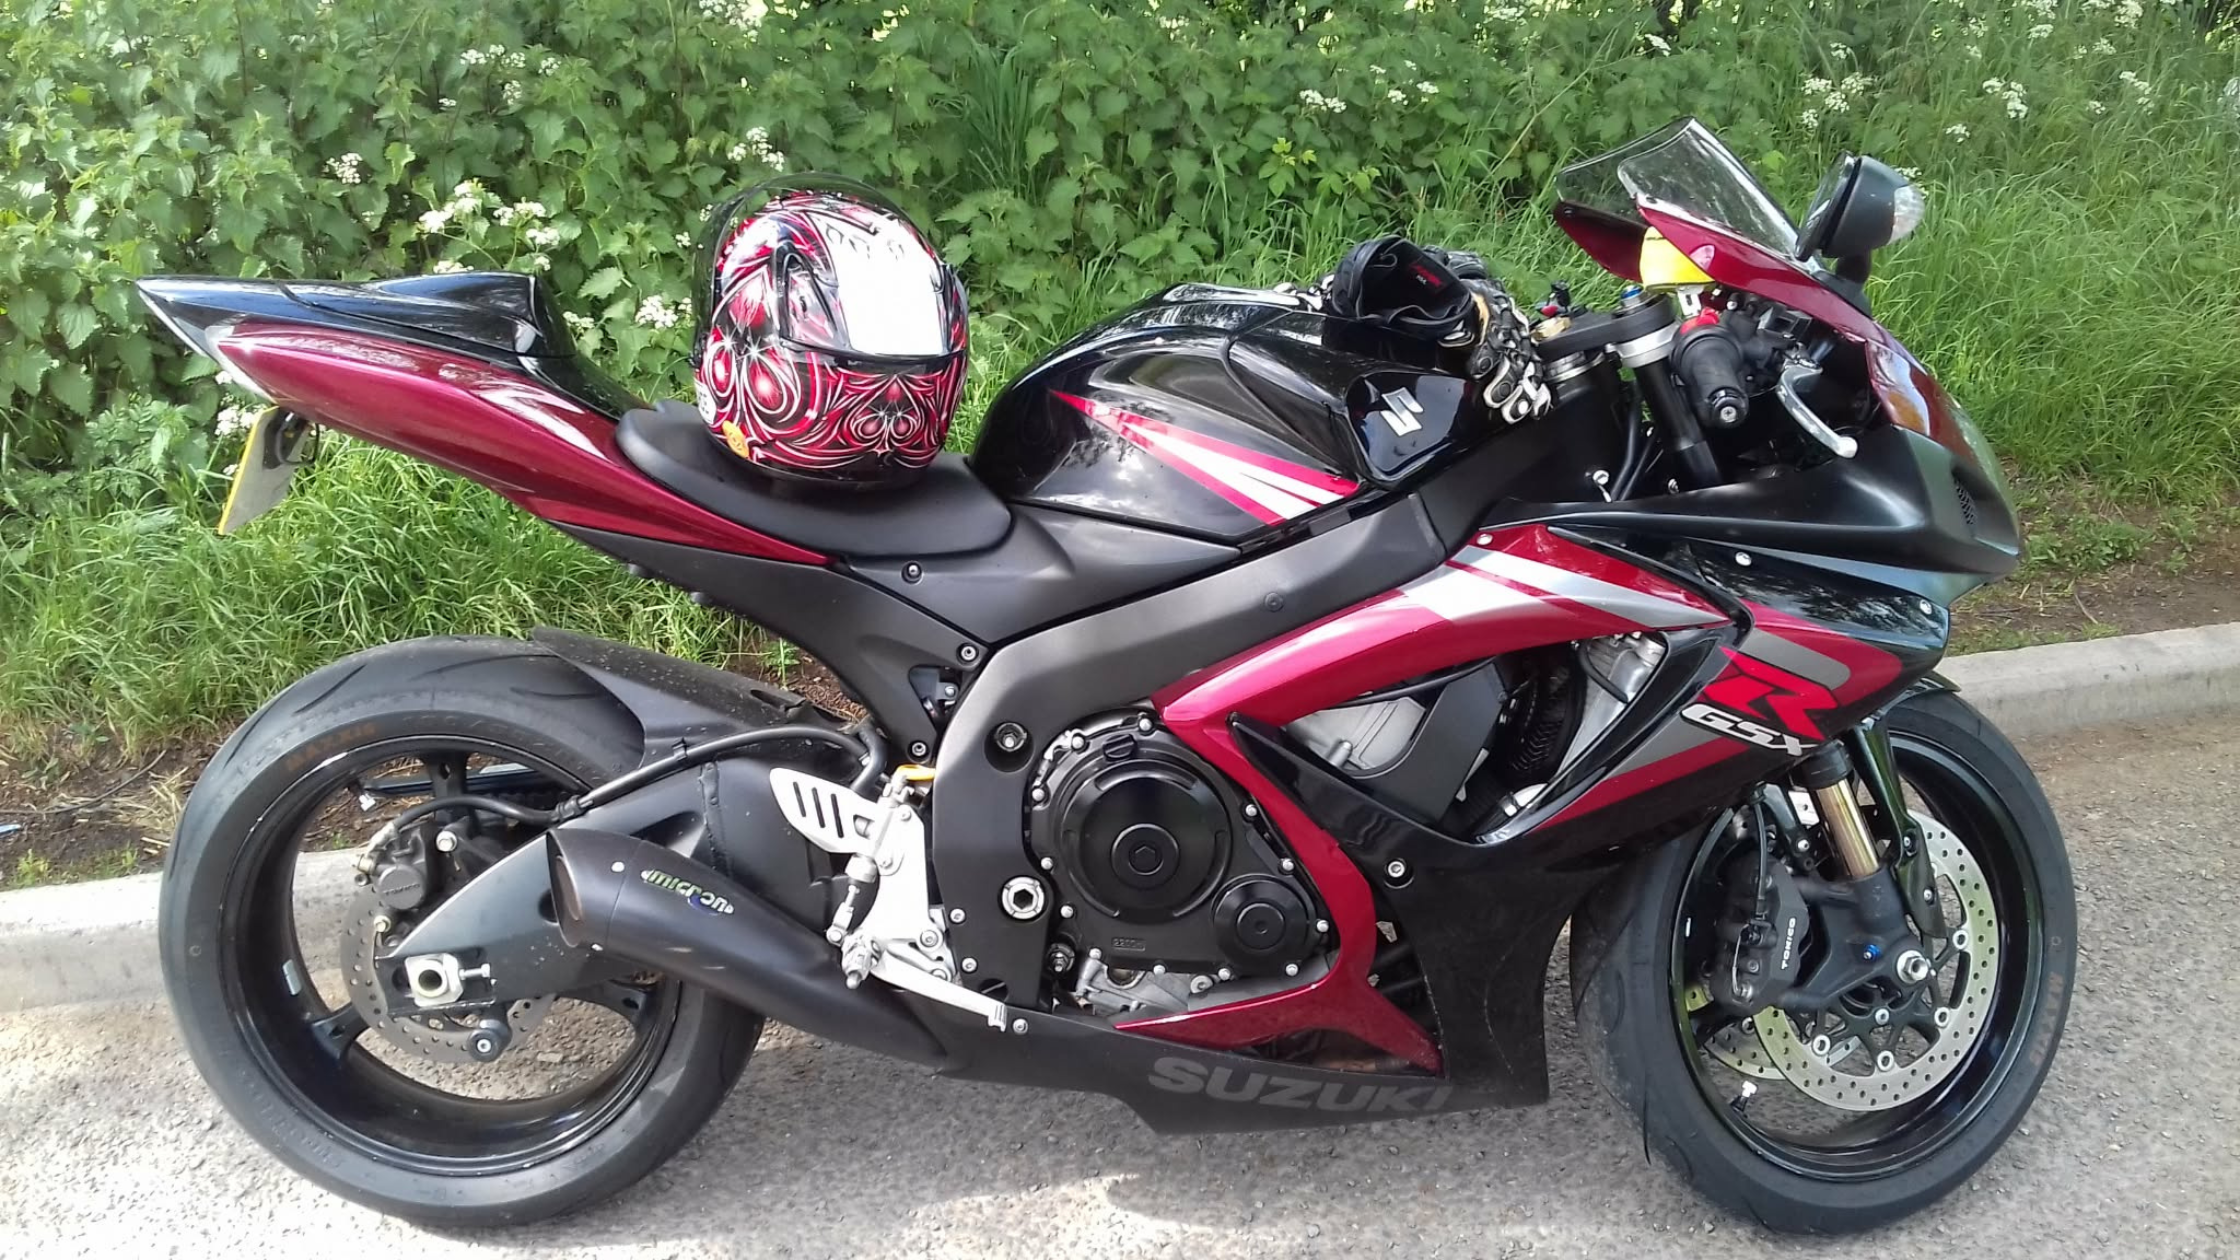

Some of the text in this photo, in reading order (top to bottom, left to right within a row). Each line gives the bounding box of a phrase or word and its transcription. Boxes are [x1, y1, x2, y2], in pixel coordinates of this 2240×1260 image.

[1703, 645, 1839, 741] R
[1681, 703, 1819, 757] GSX
[1148, 1056, 1453, 1112] SUZUKI
